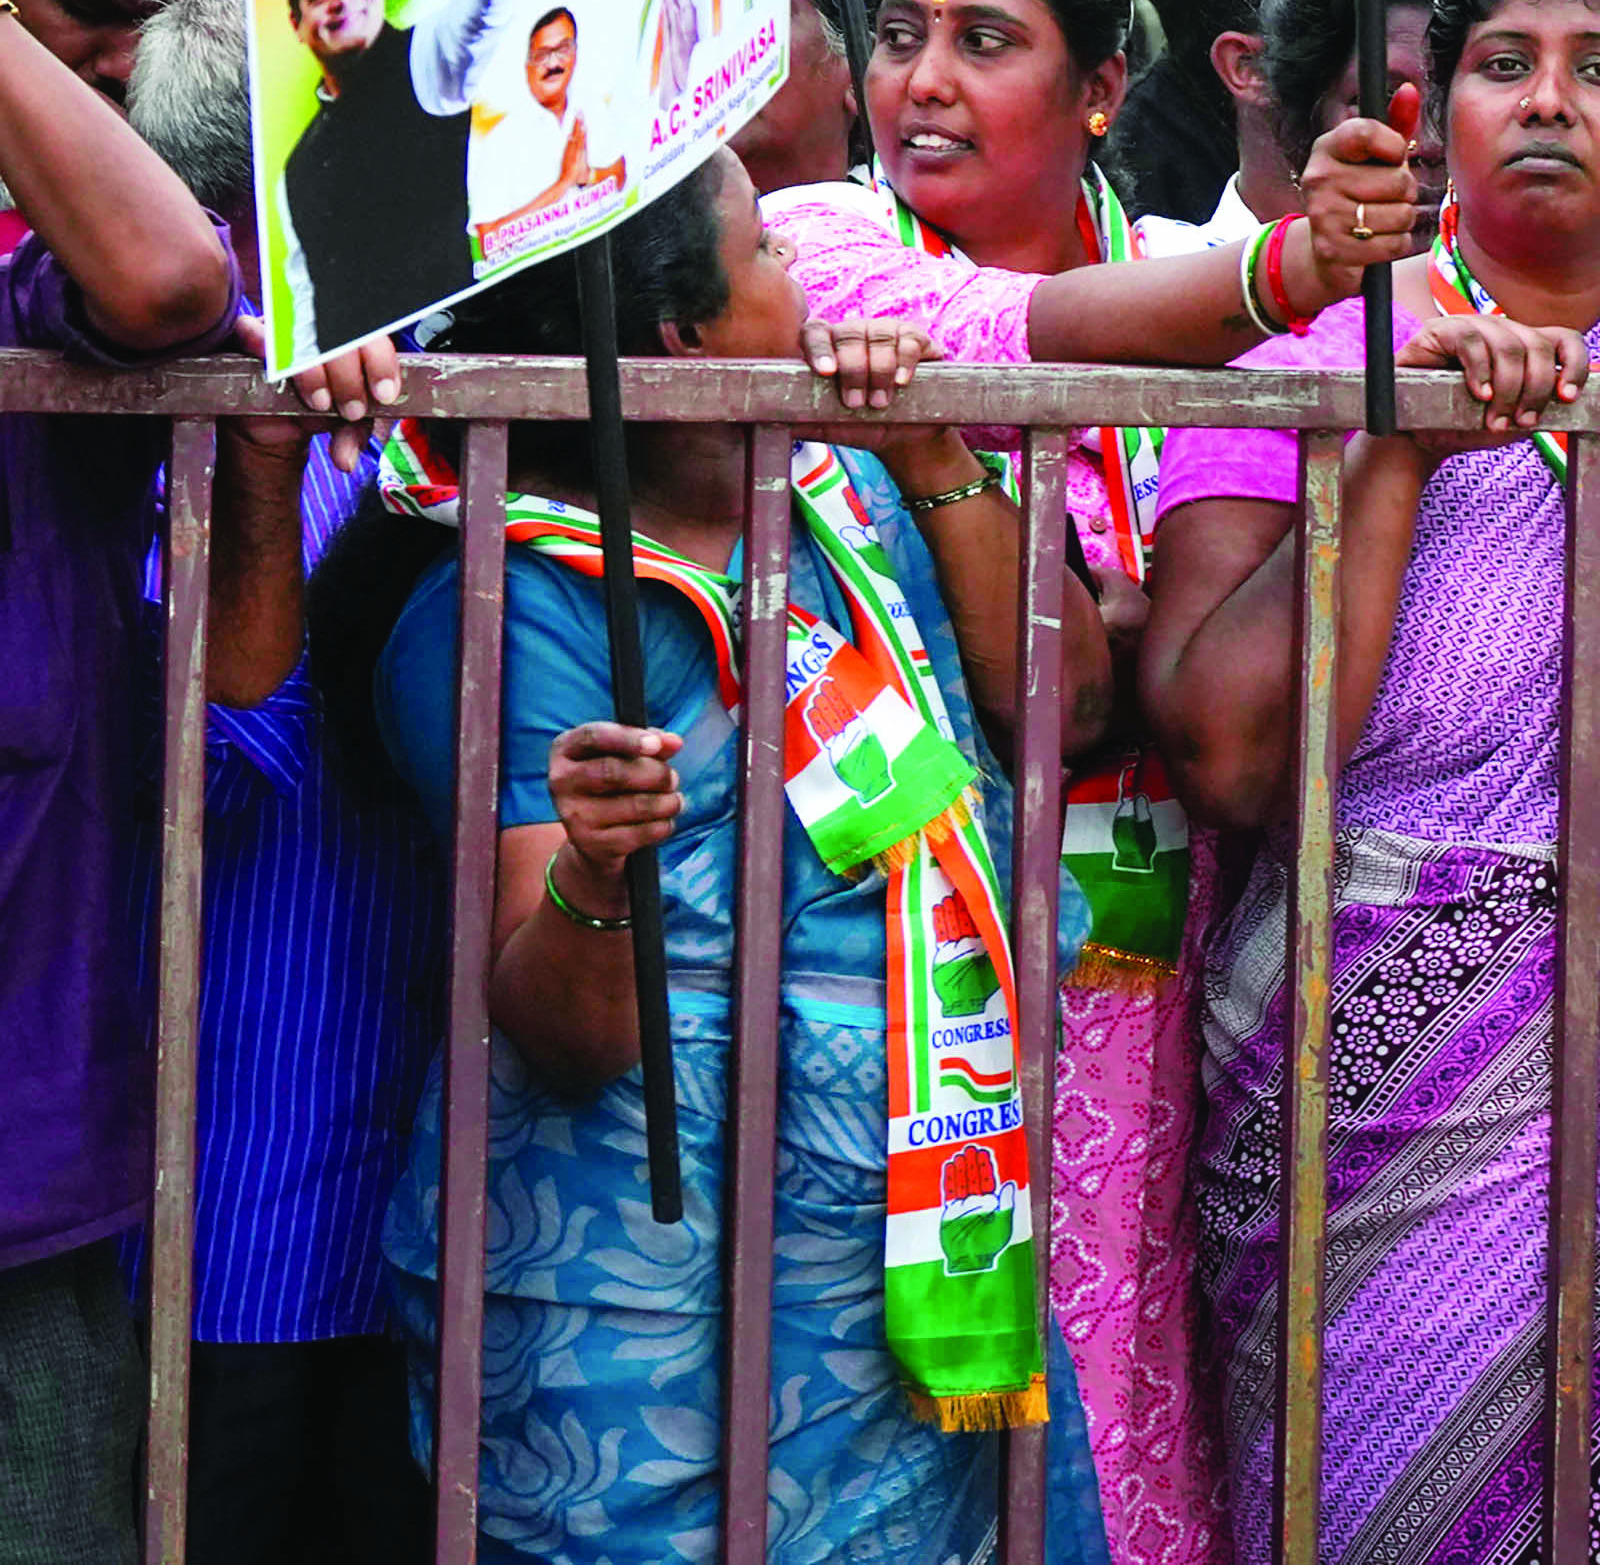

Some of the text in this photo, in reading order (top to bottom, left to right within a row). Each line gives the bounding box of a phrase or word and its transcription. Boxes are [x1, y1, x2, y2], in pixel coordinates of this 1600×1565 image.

[650, 20, 778, 152] A.C. SRINIVASA
[502, 179, 616, 244] PRASANNA KUMAR
[931, 1017, 1011, 1051] CONGRESS
